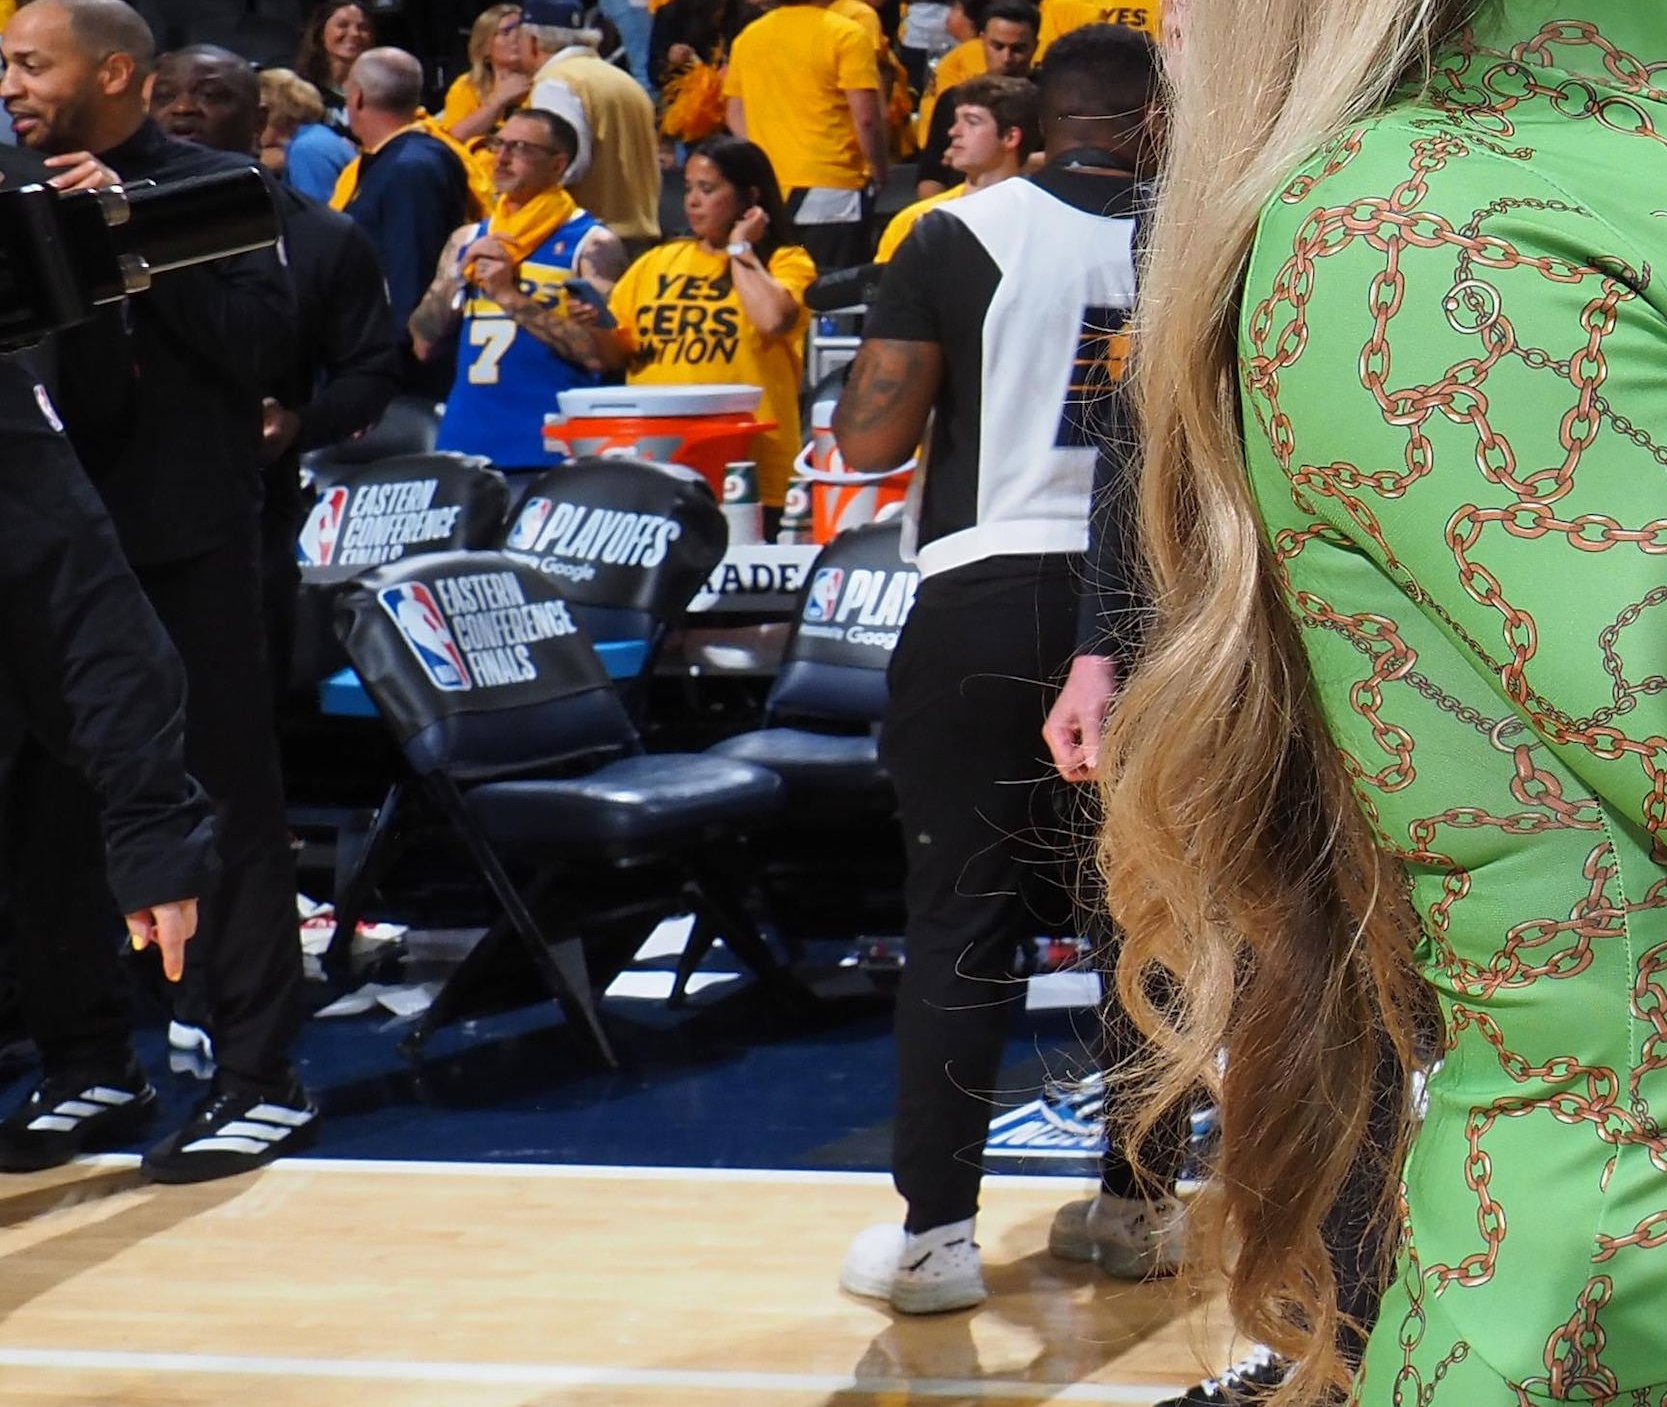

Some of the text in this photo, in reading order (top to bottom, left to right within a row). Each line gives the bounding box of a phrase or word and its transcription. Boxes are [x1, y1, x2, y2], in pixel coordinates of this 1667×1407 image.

[1101, 8, 1148, 26] YES
[656, 273, 732, 302] YES
[636, 304, 740, 339] CERS
[467, 318, 517, 385] 7
[350, 478, 440, 518] EASTERN
[342, 505, 463, 549] CONFERENCE
[533, 502, 682, 569] PLAYOFFS
[540, 556, 596, 584] Google
[700, 563, 801, 595] ADE
[434, 570, 525, 616] EASTERN
[451, 598, 578, 653] CONFERENCE
[467, 644, 538, 689] FINALS
